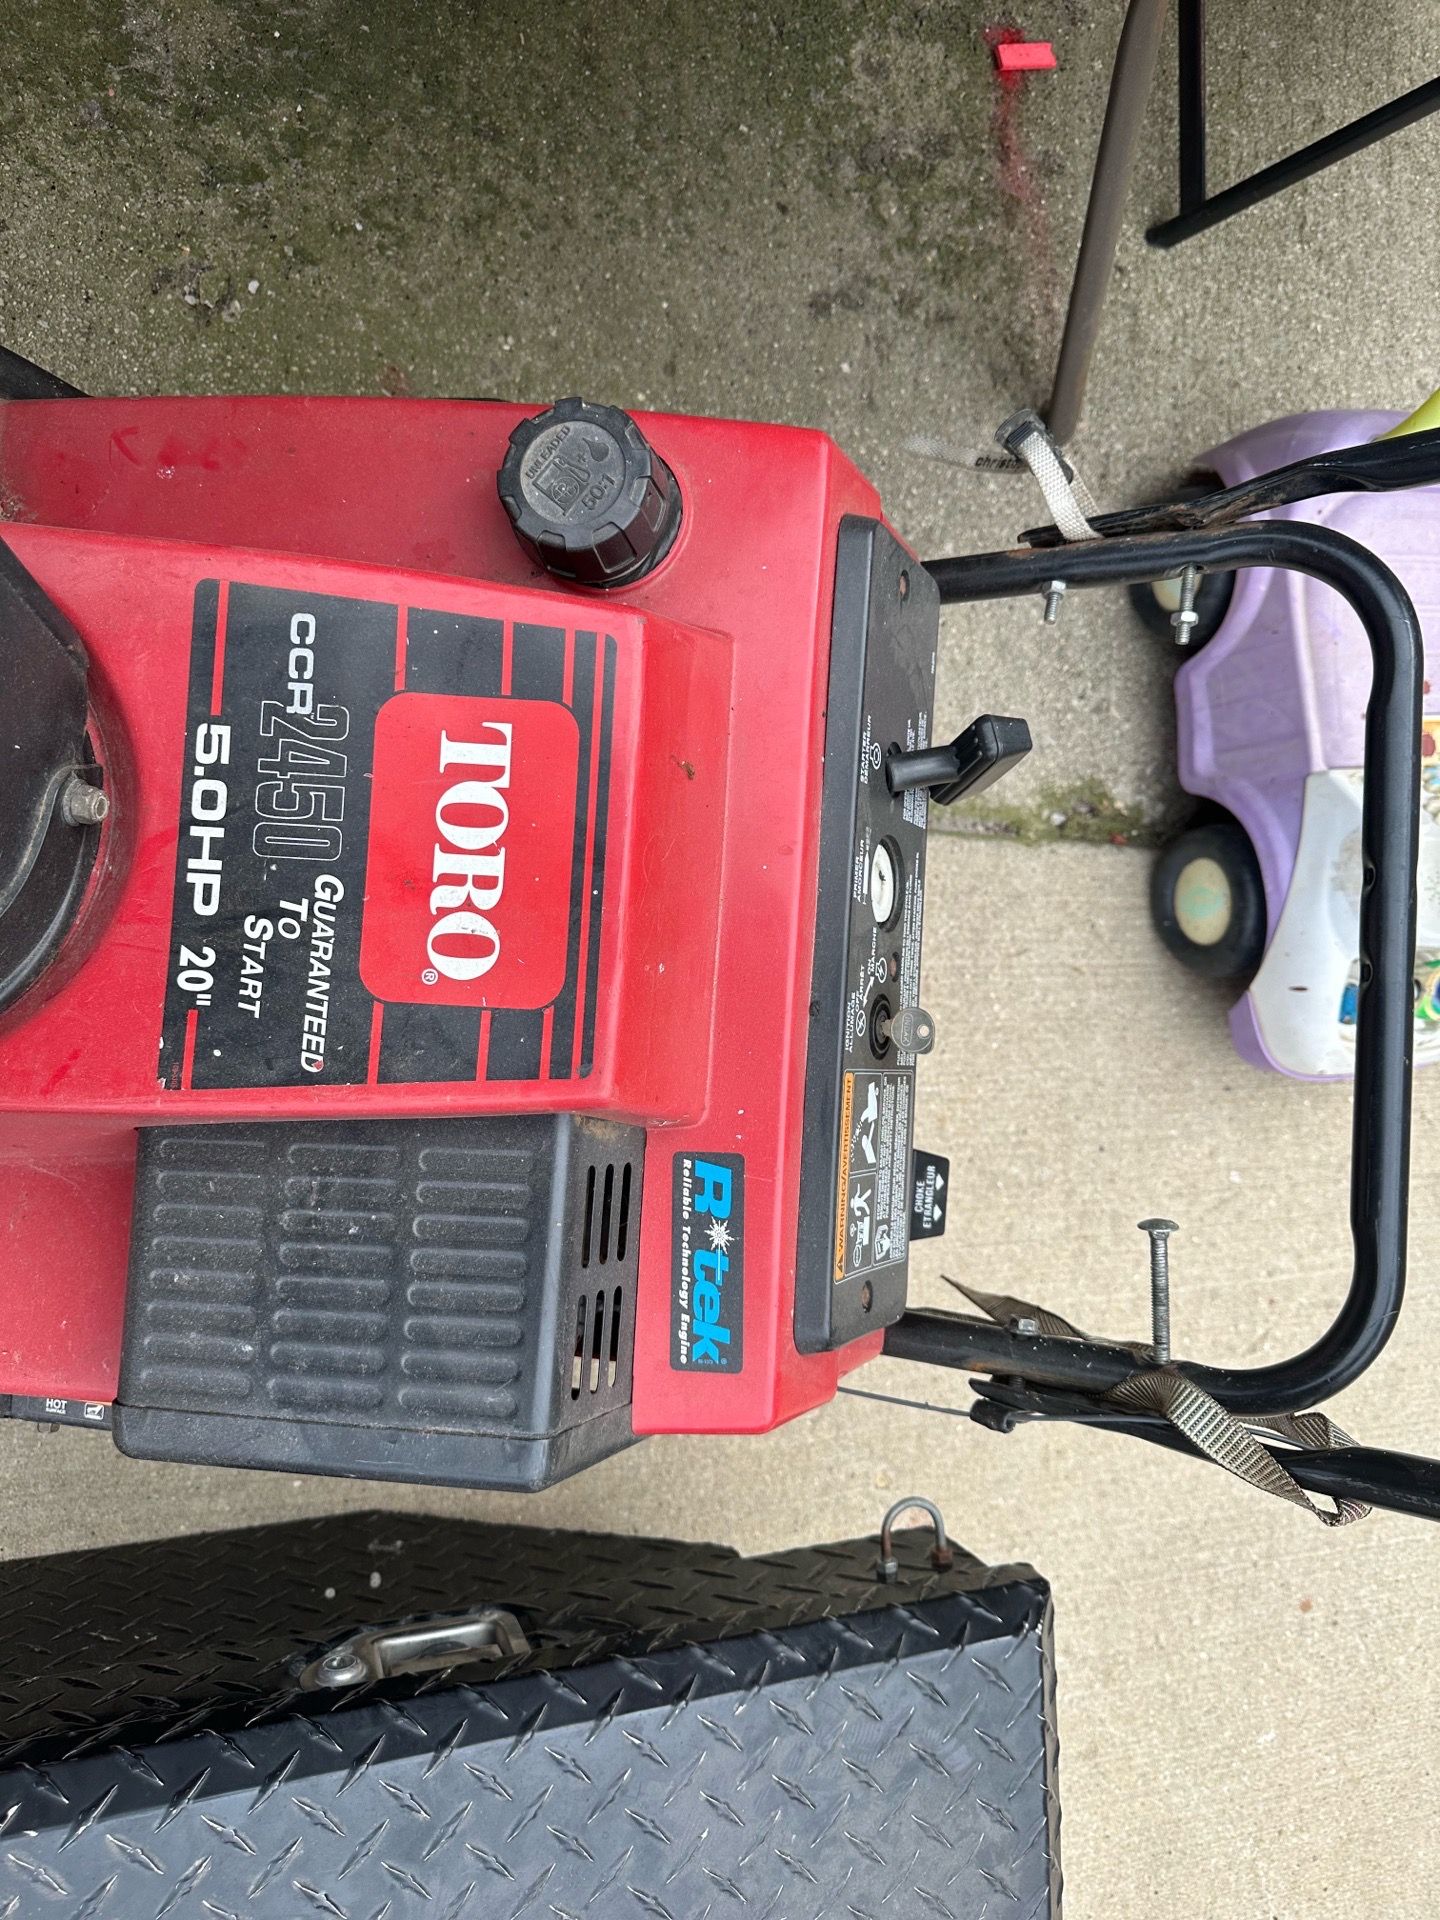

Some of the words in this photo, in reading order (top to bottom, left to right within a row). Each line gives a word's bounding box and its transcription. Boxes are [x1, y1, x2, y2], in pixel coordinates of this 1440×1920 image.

[526, 426, 570, 480] UNLEADED
[285, 612, 317, 715] CCR
[252, 701, 349, 861] 2450
[185, 722, 231, 916] 5.0HP
[426, 721, 513, 981] TORO
[277, 898, 308, 939] TO
[176, 944, 216, 1006] 20"
[237, 915, 272, 1018] START
[299, 874, 345, 1073] GUARANTEED
[682, 1158, 692, 1220] Reliable
[914, 1180, 924, 1212] CHOKE
[922, 1165, 935, 1228] ETRANGLEUR
[679, 1226, 691, 1310] Technology
[678, 1313, 689, 1364] Engine
[46, 1398, 68, 1410] HOT
